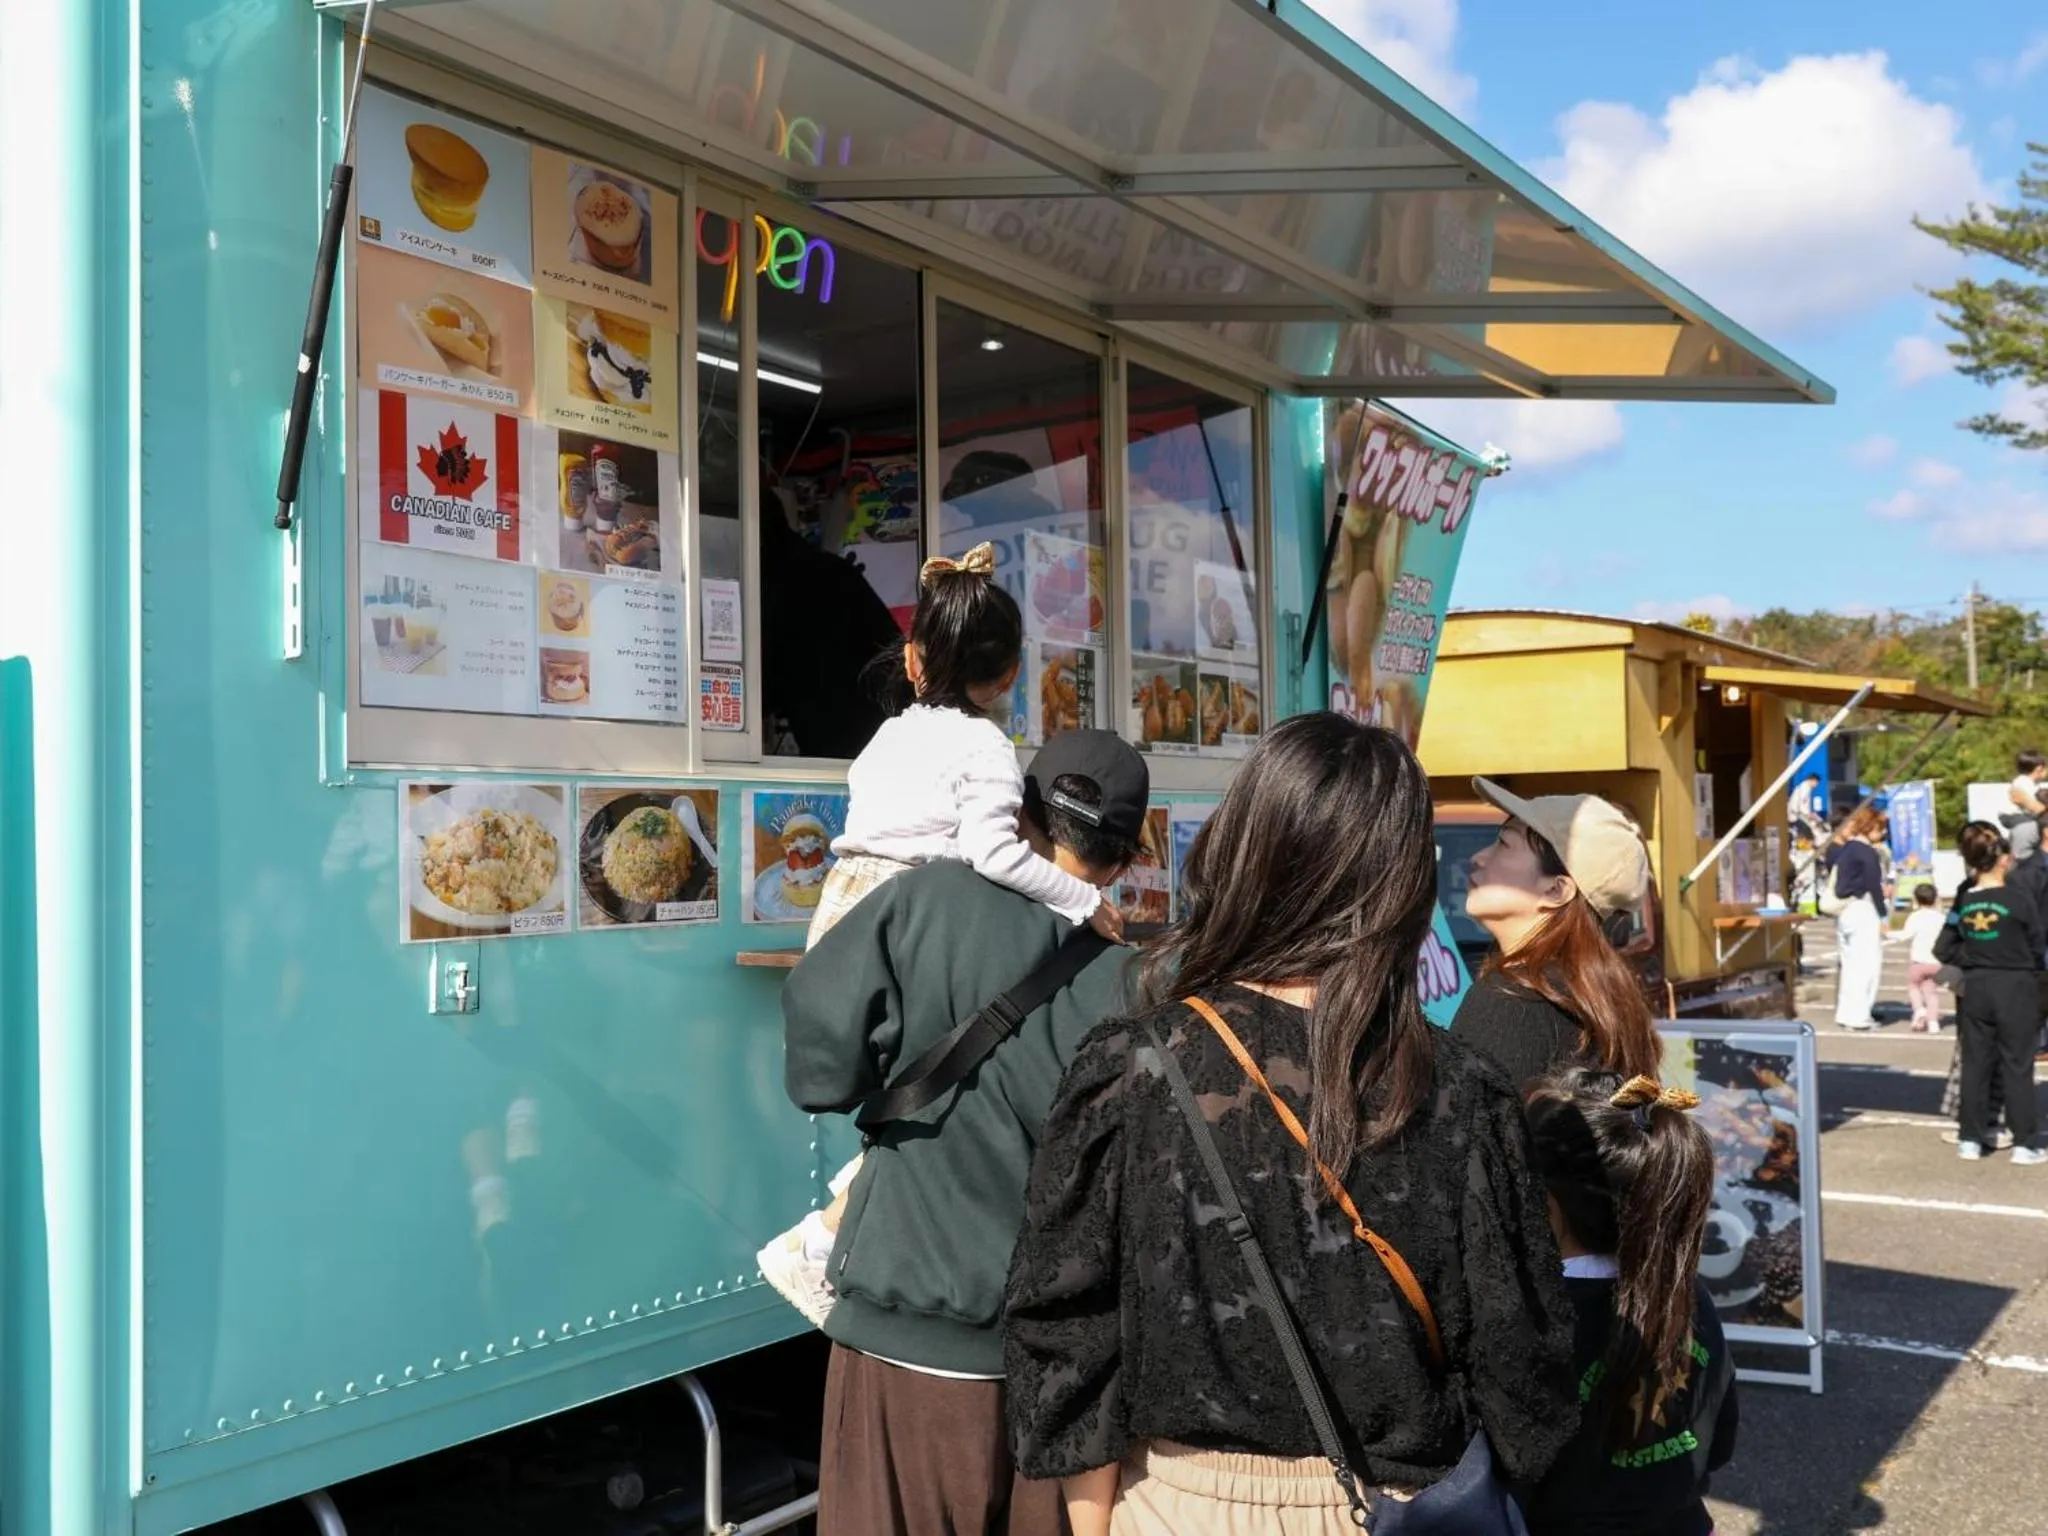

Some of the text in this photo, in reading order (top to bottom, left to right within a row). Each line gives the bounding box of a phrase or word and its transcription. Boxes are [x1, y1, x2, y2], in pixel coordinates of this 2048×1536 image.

[383, 367, 457, 390] パンケーキバーガー
[391, 494, 512, 531] CANADIAN CAFE
[514, 916, 538, 928] ピラフ
